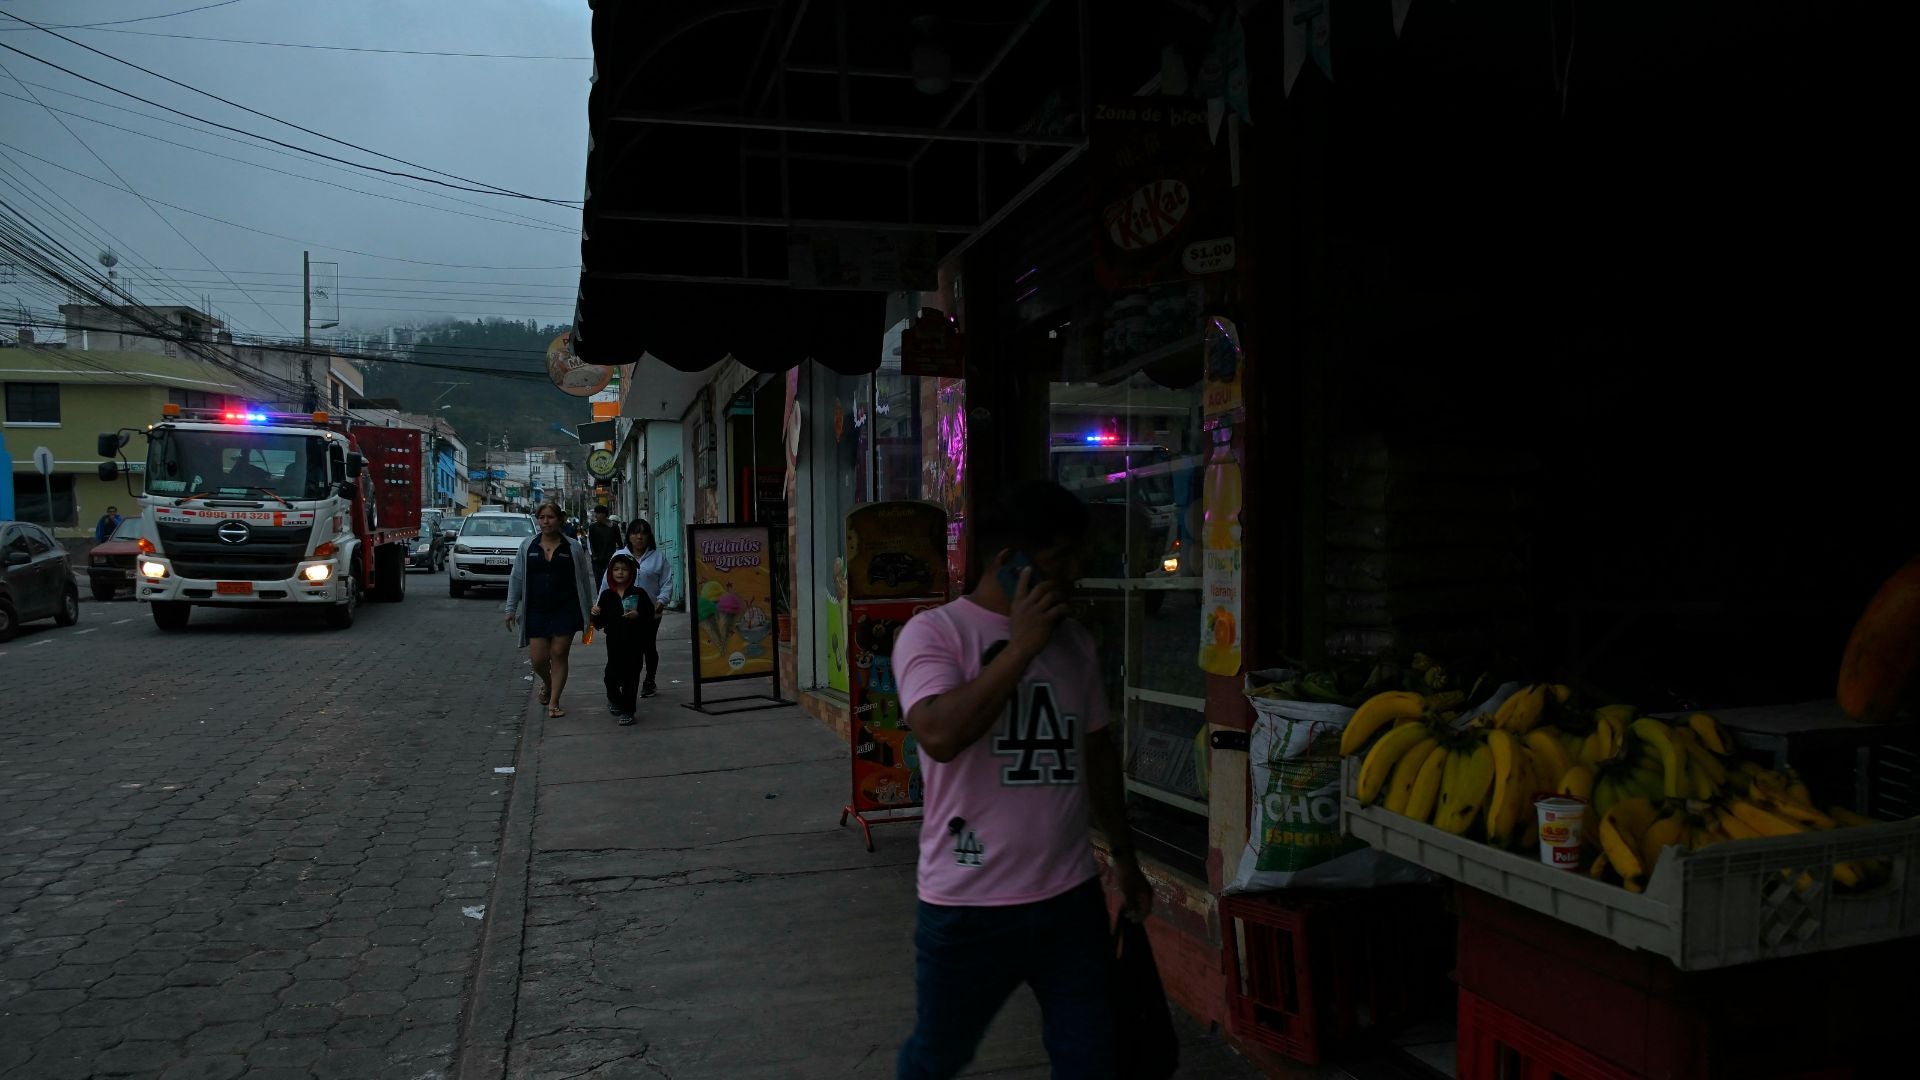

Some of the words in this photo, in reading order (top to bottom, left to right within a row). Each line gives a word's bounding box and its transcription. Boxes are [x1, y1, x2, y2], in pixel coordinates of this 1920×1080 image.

[1095, 103, 1137, 121] Zona
[1141, 106, 1162, 122] de
[1116, 180, 1187, 249] KitKat
[250, 512, 271, 520] 328
[702, 538, 760, 555] Helados
[715, 554, 760, 572] Queso
[992, 682, 1079, 784] LA
